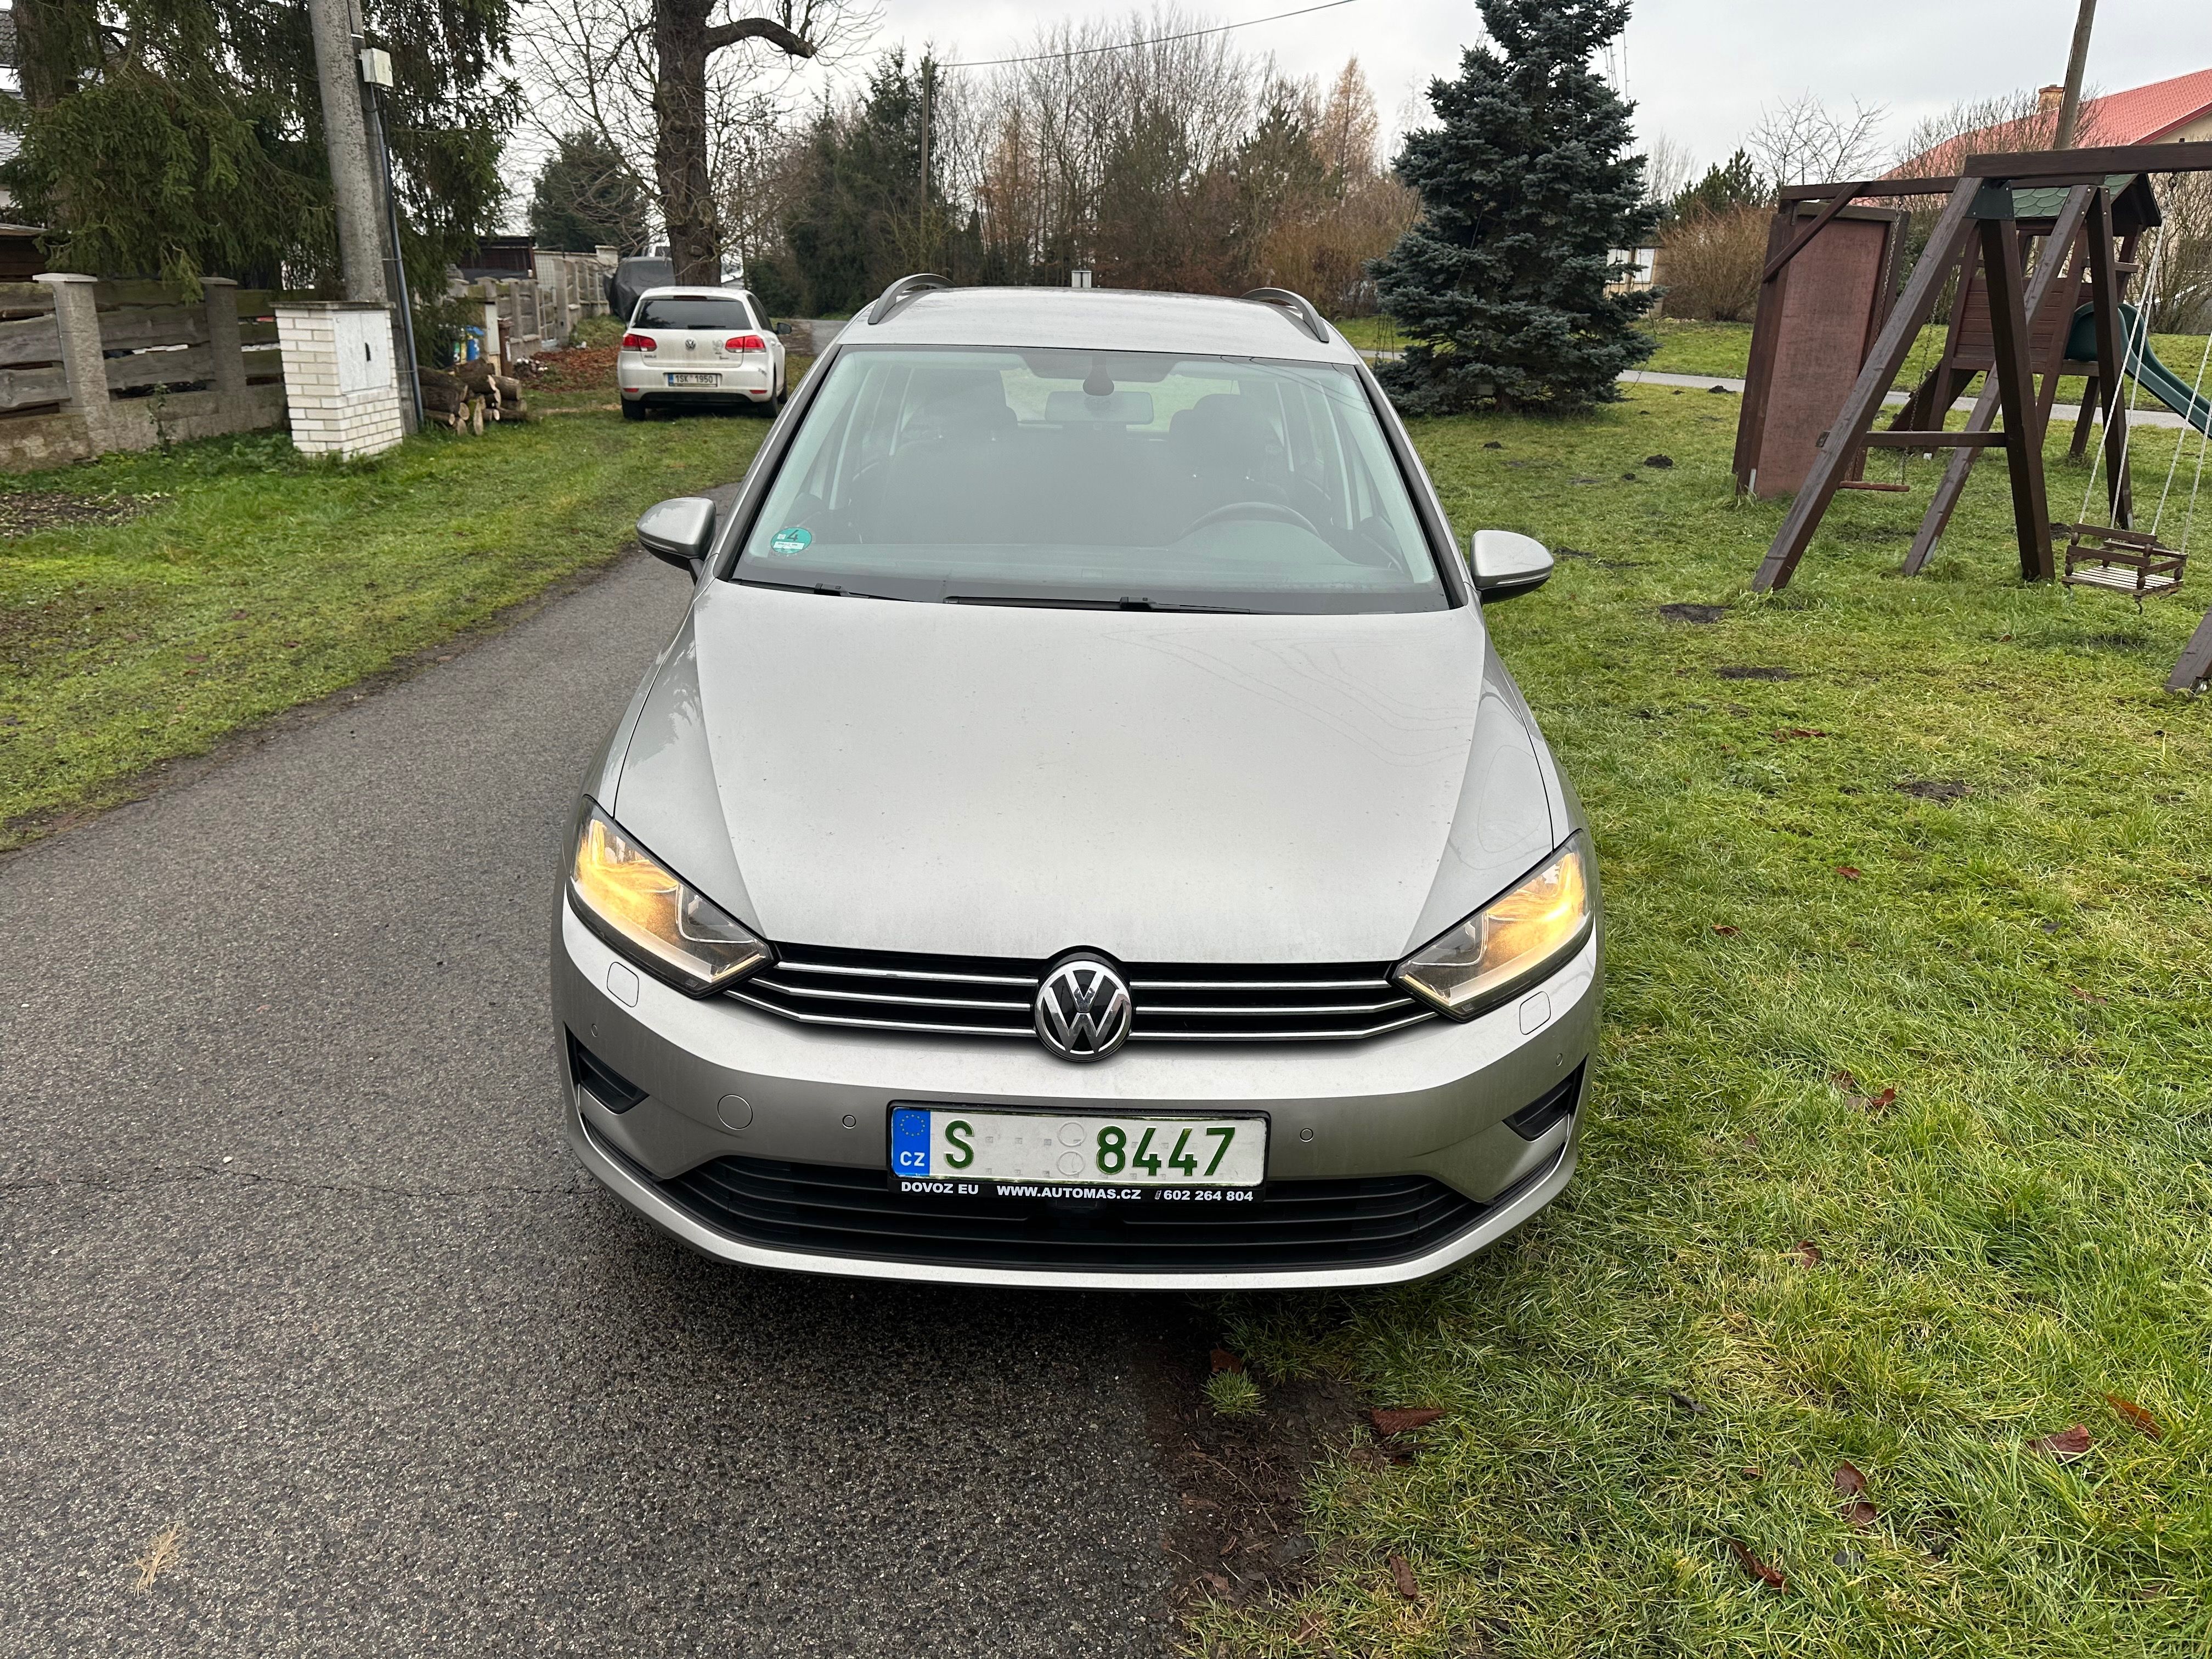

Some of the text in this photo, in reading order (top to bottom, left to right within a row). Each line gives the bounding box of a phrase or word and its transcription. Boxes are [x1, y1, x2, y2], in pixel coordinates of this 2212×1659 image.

[675, 375, 689, 383] 1SK
[695, 375, 713, 383] 1950
[786, 529, 799, 541] 4
[944, 1119, 1236, 1177] S 8447
[900, 1151, 925, 1167] CZ
[901, 1181, 1254, 1201] DOVOZ EU WWW.AUTOMAS.CZ 602 264 804
